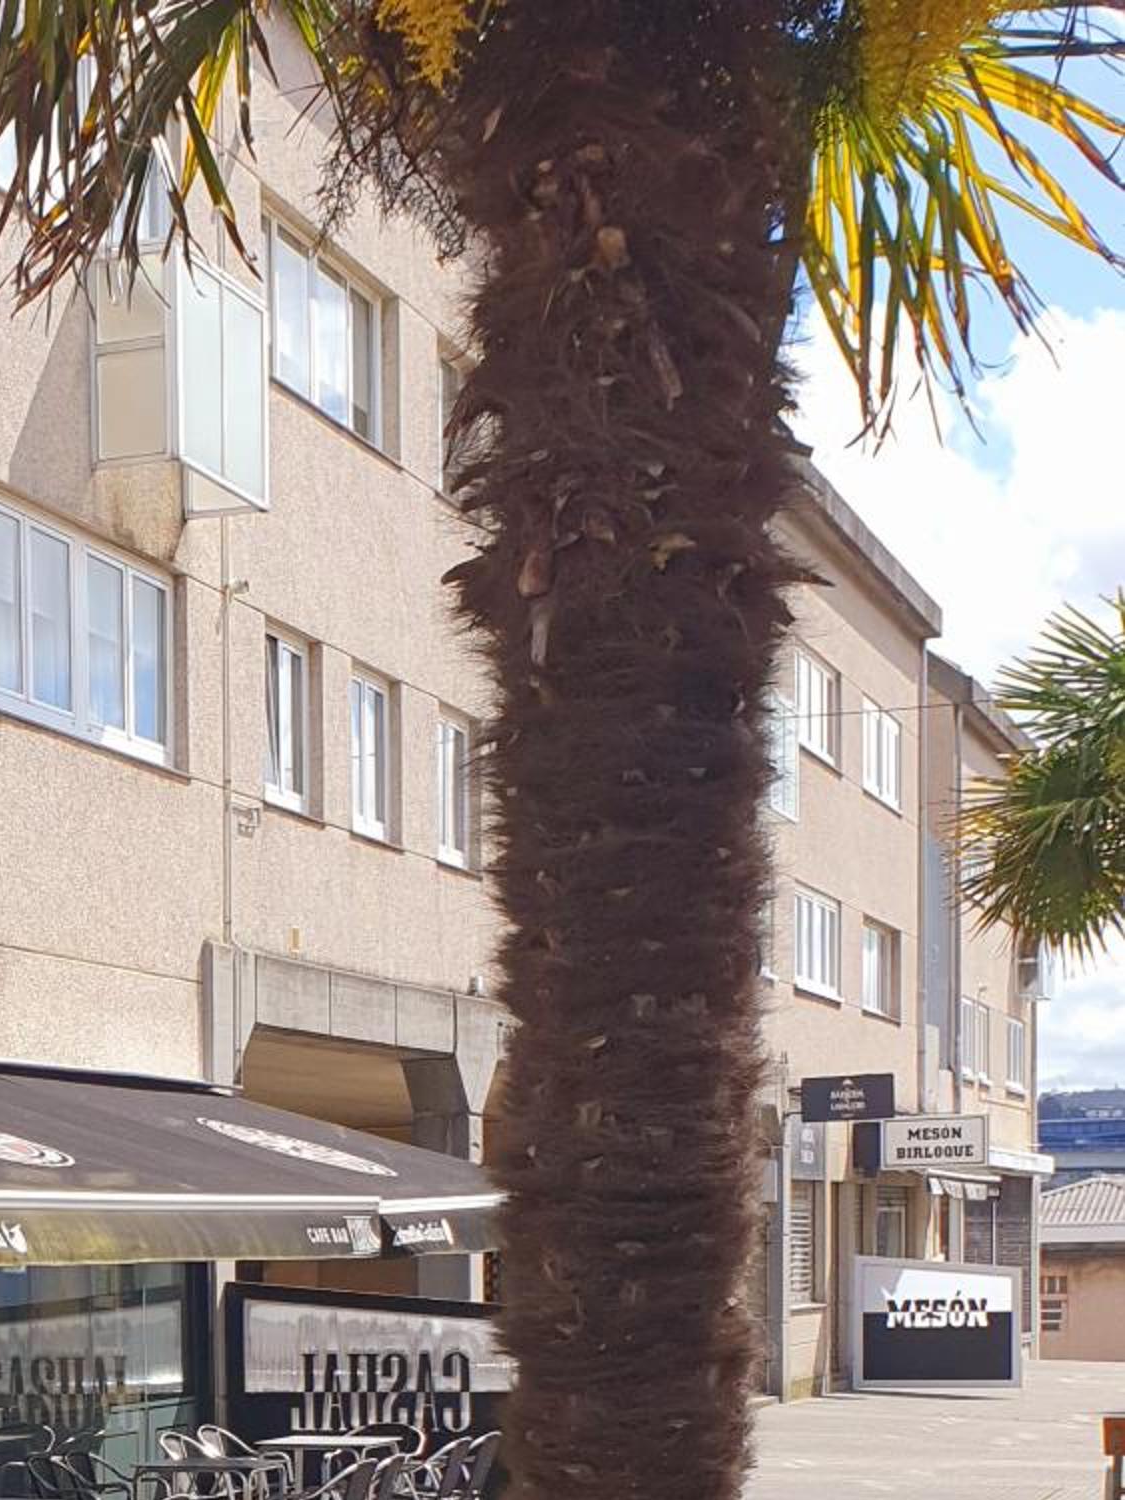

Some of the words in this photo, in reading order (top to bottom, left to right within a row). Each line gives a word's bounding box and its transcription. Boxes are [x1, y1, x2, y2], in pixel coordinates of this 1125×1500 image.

[907, 1123, 962, 1141] MESÓN
[896, 1145, 974, 1160] BIRLOQUE
[886, 1290, 988, 1328] MESÓN
